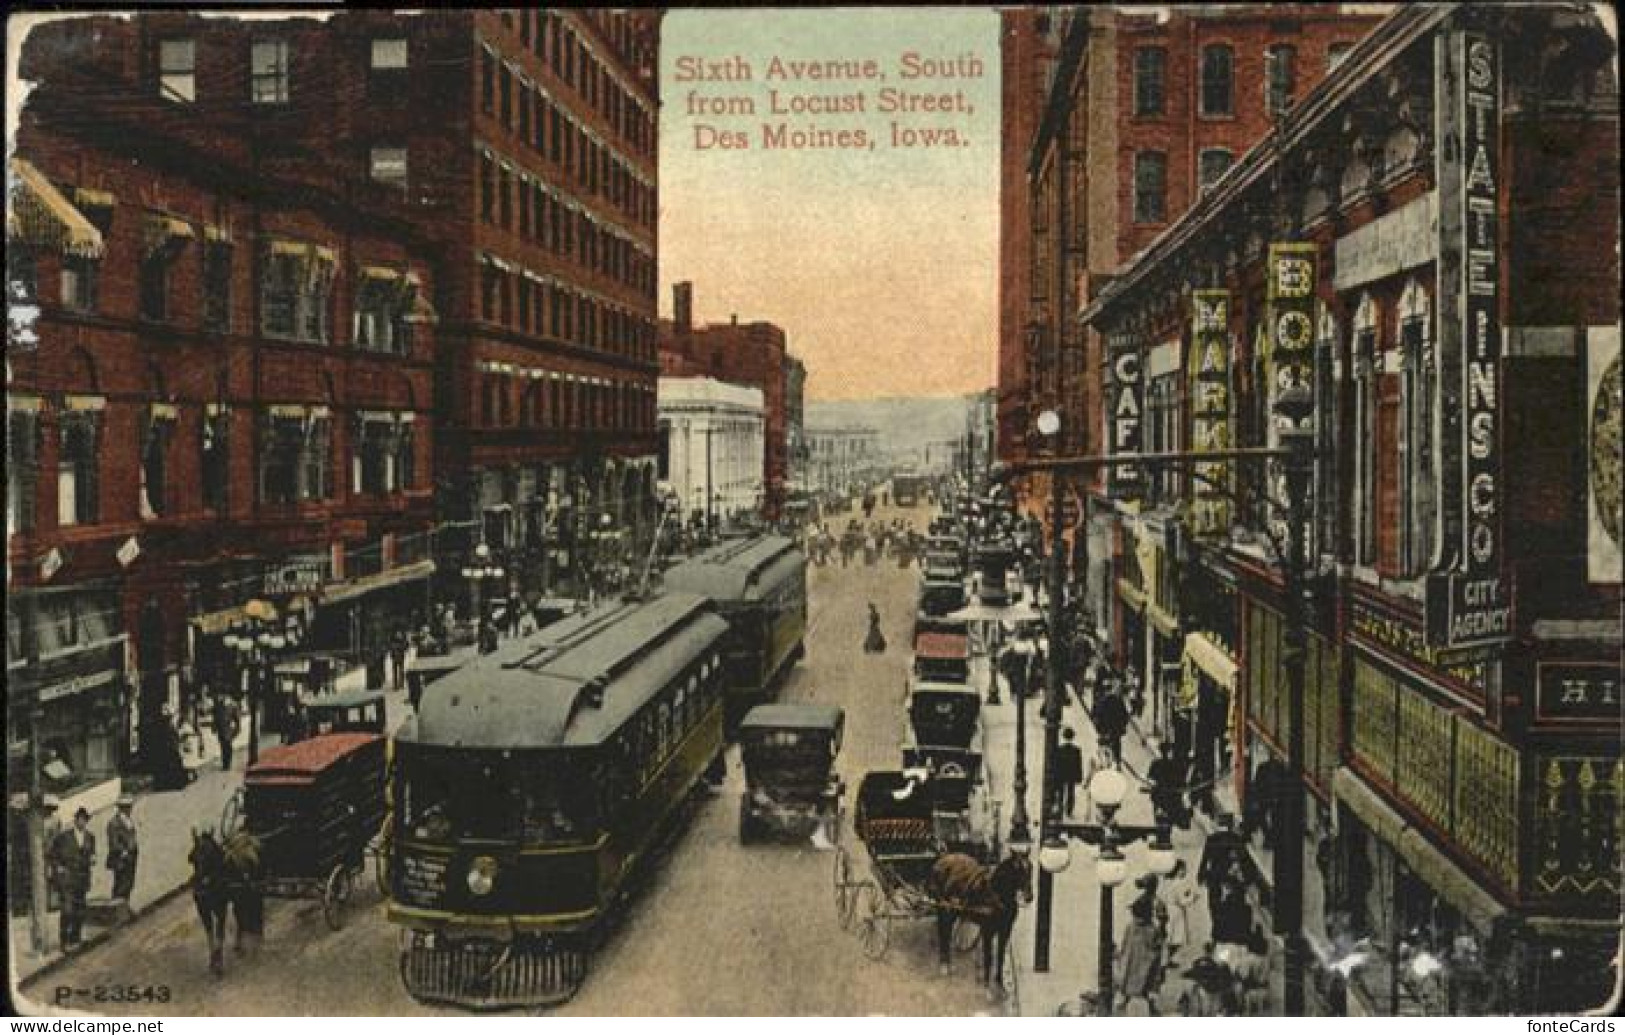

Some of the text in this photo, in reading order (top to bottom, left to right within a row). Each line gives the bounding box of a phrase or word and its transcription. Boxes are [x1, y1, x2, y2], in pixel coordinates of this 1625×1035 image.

[1467, 41, 1495, 295] STATE
[1116, 353, 1140, 480] CAFE
[1453, 607, 1510, 638] AGENCY
[1465, 579, 1499, 606] CITY
